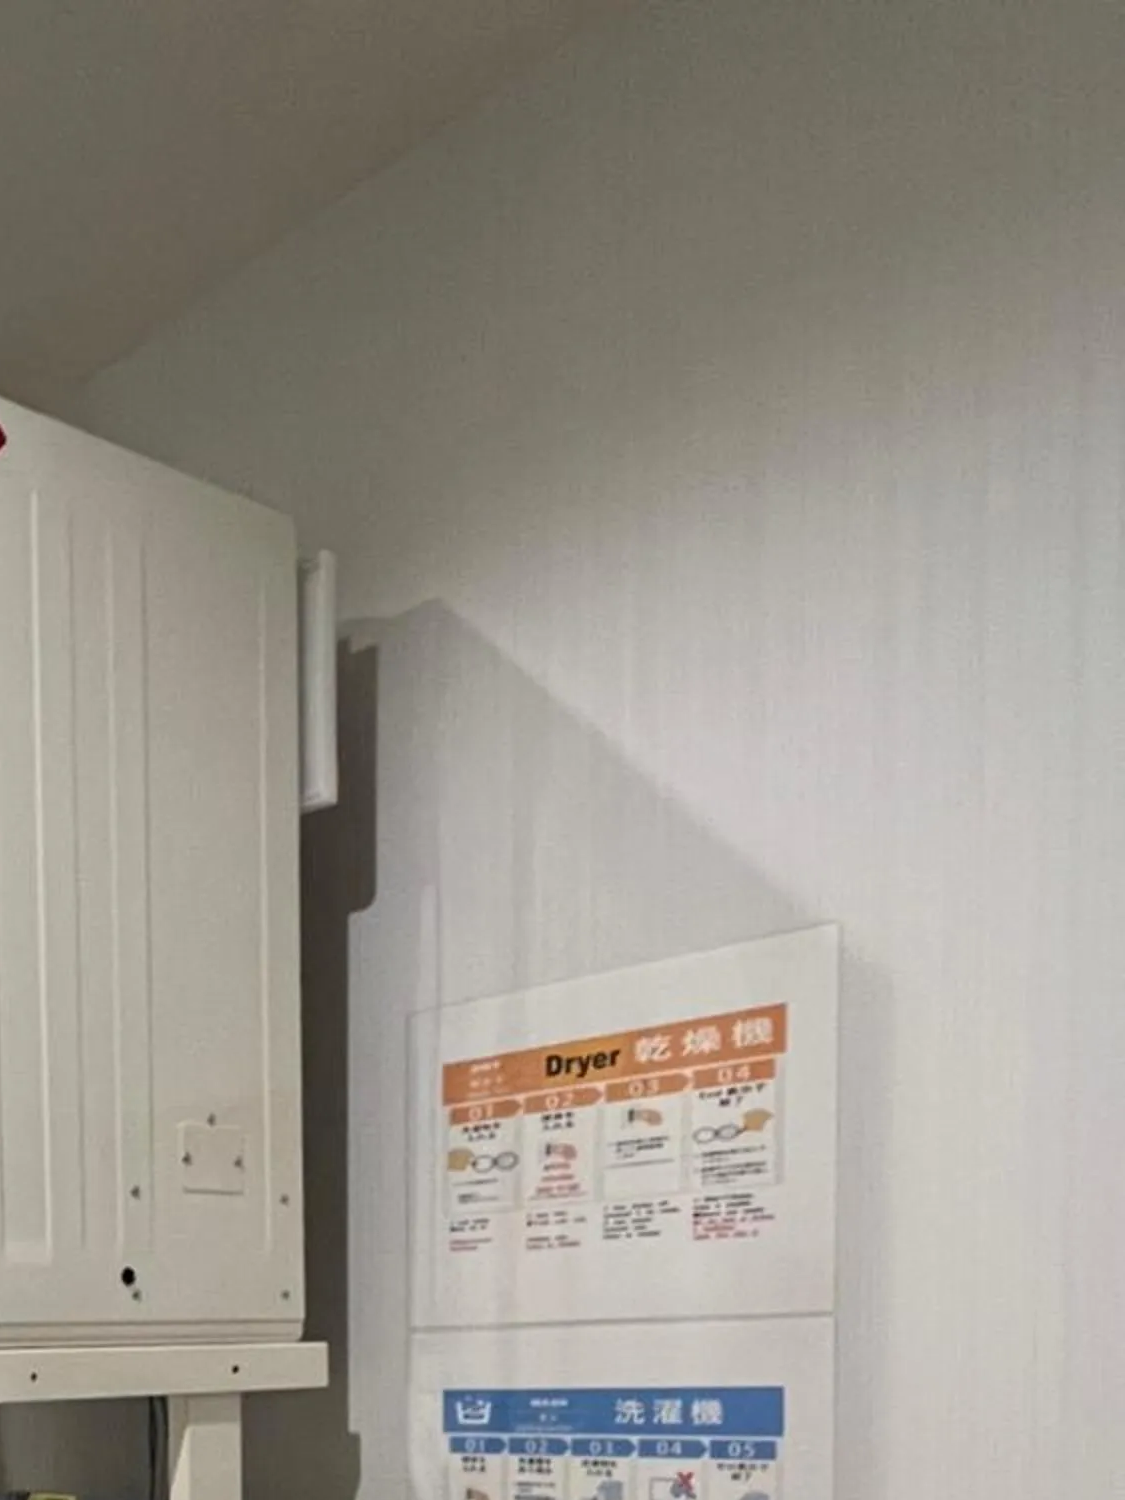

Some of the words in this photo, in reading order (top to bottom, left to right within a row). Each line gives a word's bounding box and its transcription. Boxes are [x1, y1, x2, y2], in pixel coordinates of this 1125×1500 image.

[545, 1047, 620, 1078] Dryer
[614, 1398, 723, 1426] 洗濯機
